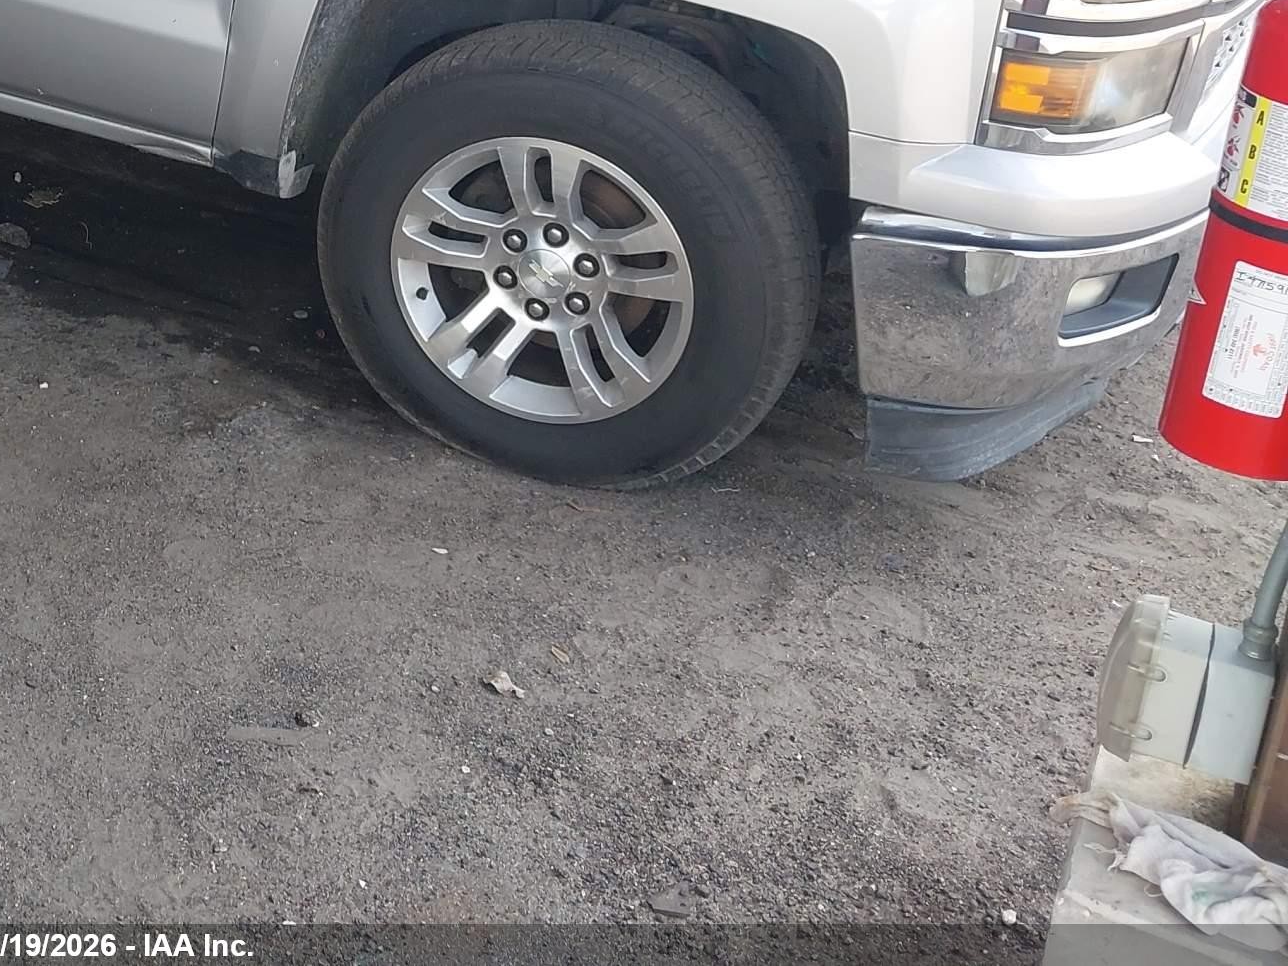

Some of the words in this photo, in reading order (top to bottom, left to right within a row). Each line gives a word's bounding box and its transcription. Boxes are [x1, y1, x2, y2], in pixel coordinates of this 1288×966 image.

[1256, 110, 1265, 126] A
[1248, 144, 1257, 160] B
[1240, 178, 1249, 194] C
